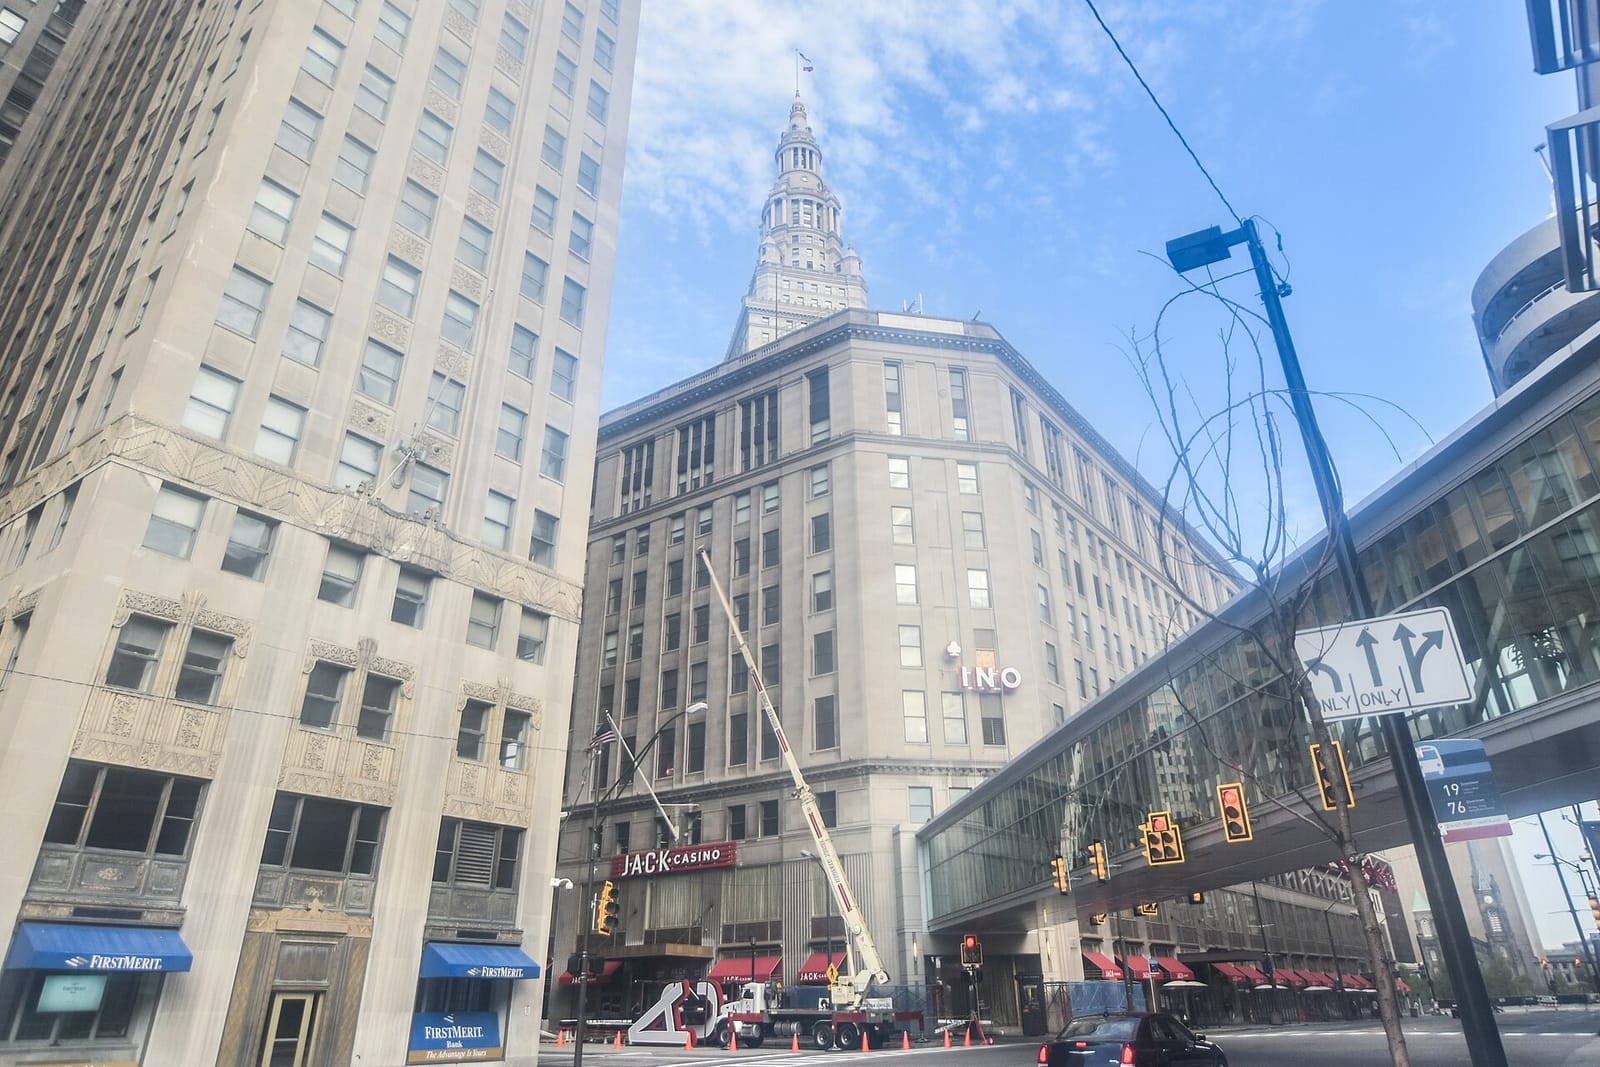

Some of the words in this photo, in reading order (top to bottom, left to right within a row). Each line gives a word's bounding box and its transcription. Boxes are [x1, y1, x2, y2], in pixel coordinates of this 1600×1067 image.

[1320, 695, 1352, 712] NLY
[1360, 687, 1402, 707] ONLY
[1443, 783, 1459, 797] 19
[1447, 801, 1466, 815] 76
[621, 850, 670, 877] JACK
[673, 849, 721, 865] CASINO
[723, 976, 739, 984] JACK
[800, 972, 818, 981] JACK
[446, 1040, 463, 1048] Bank
[426, 1051, 437, 1059] The
